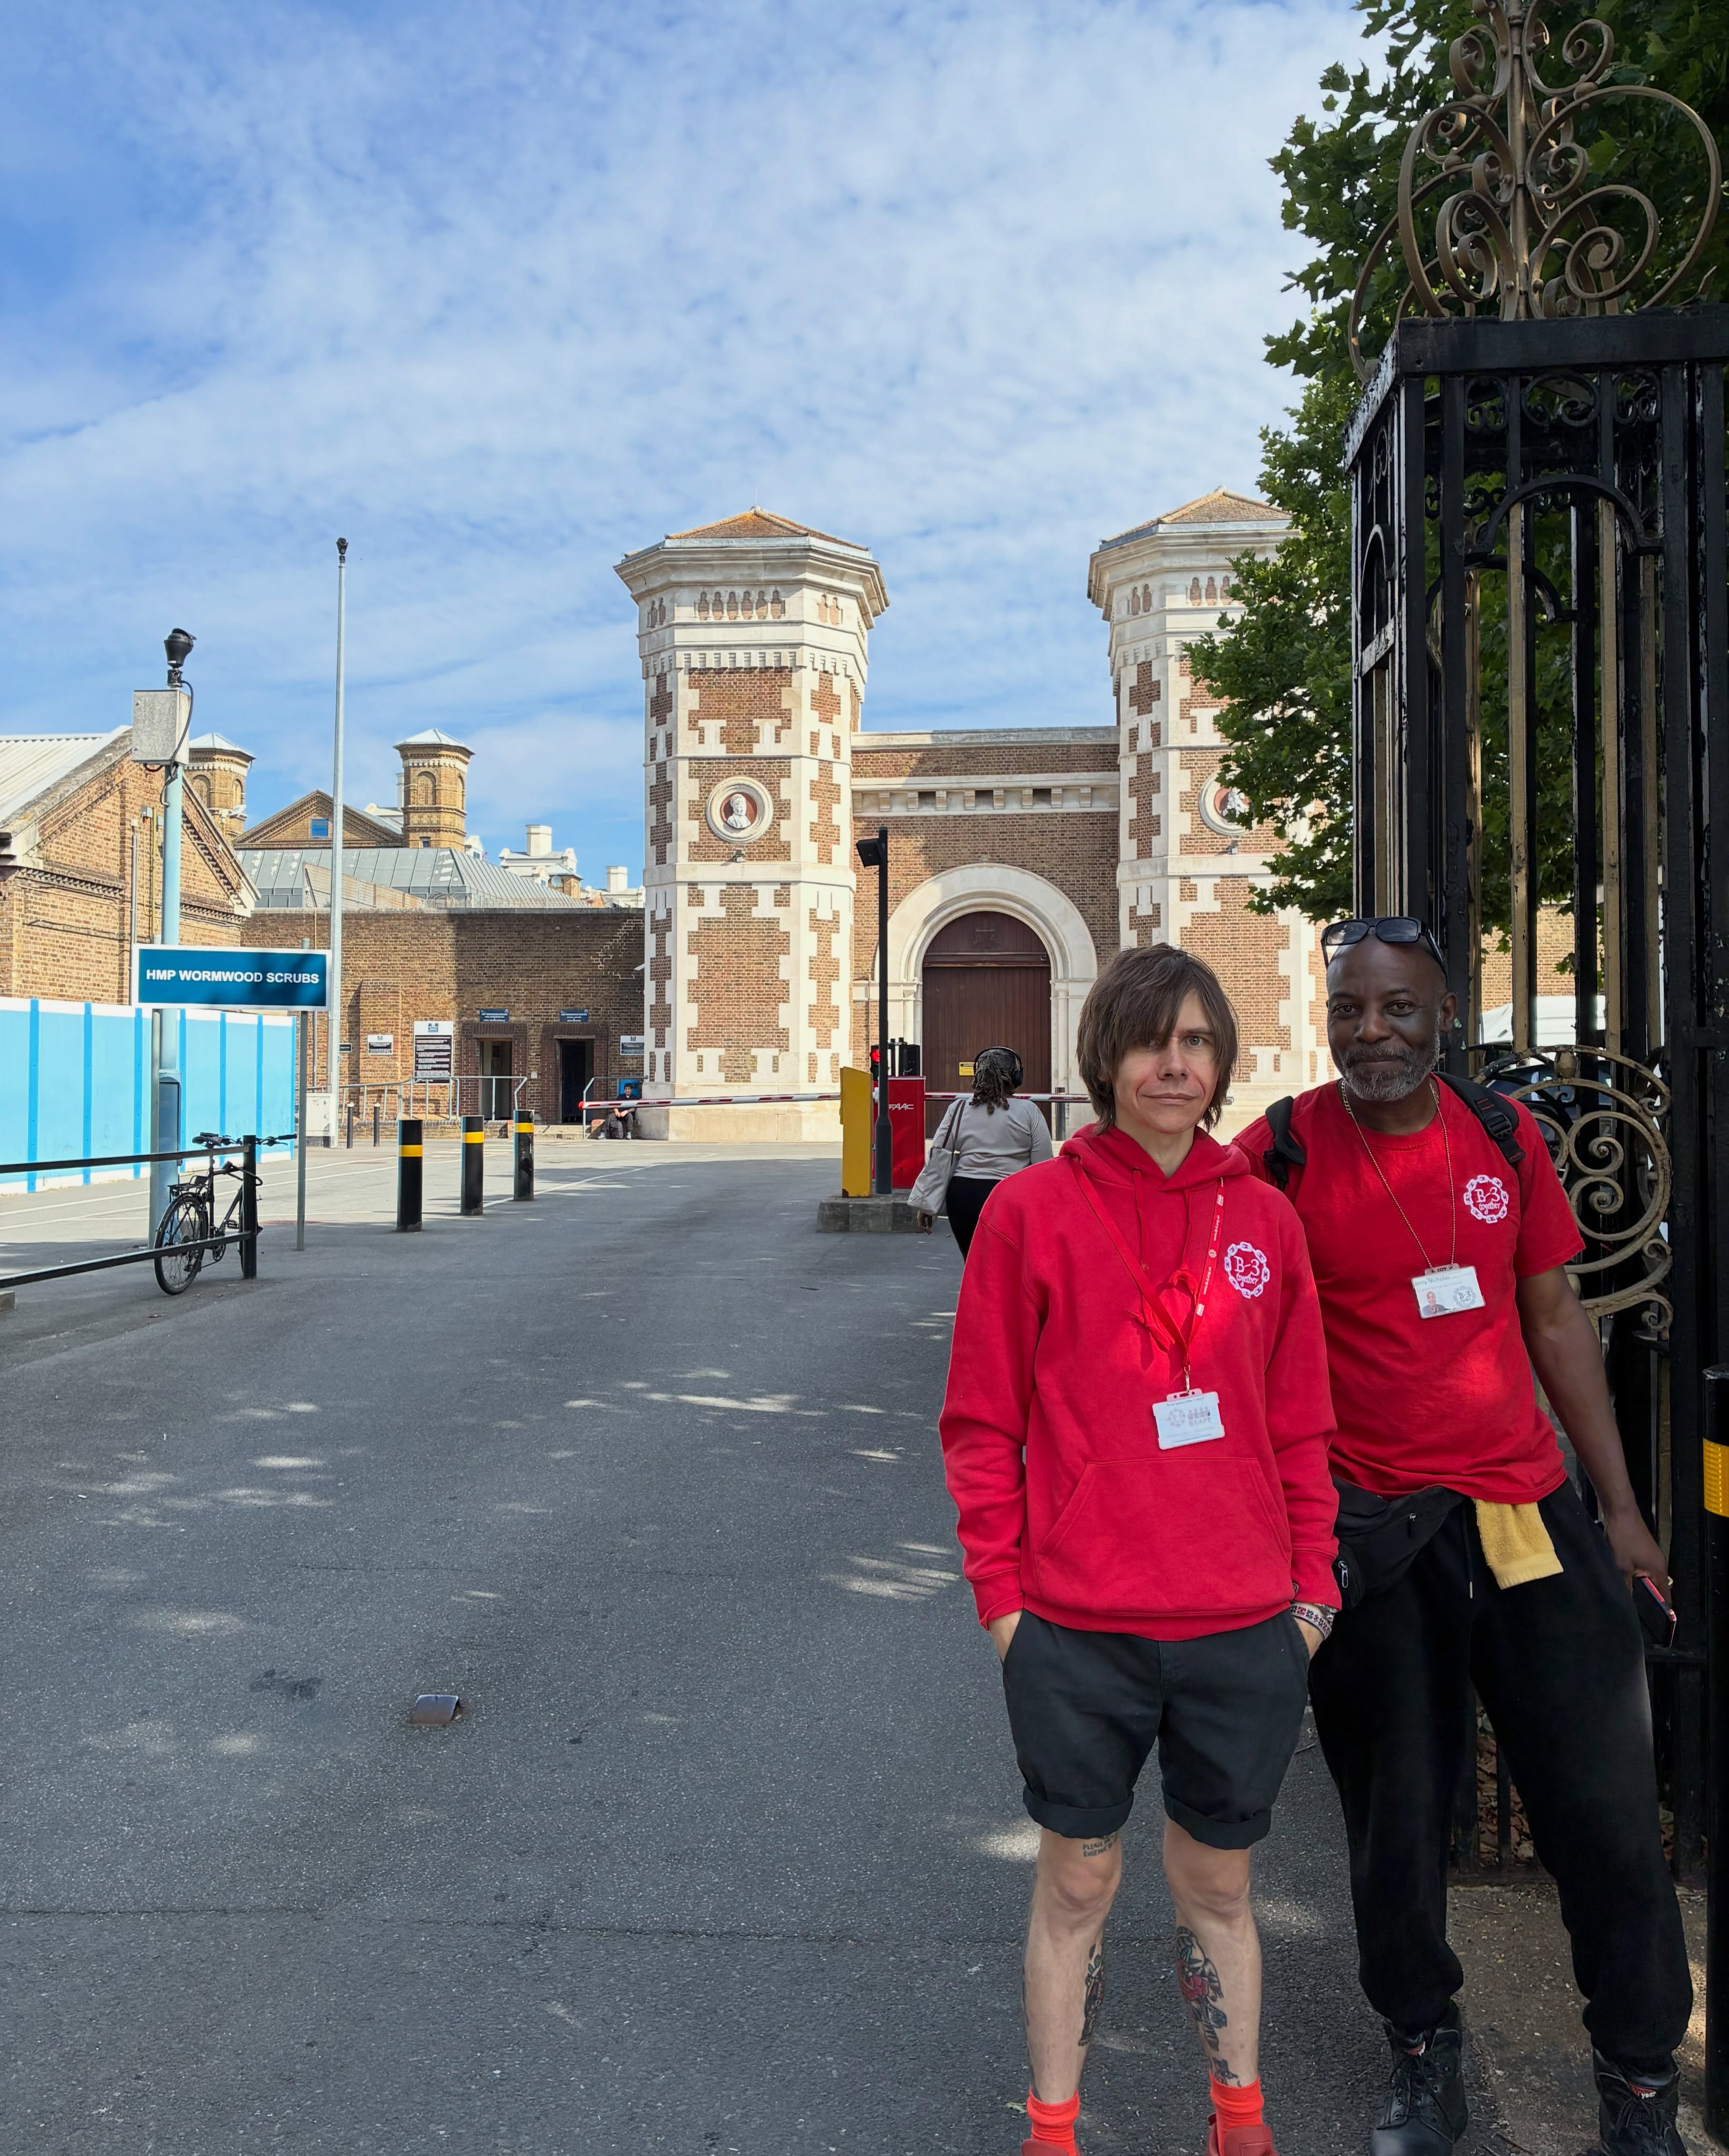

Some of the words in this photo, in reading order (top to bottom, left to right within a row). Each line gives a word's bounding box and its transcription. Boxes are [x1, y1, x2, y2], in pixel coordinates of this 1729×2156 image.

[146, 969, 176, 981] HMP
[179, 970, 263, 982] WORMWOOD
[266, 972, 319, 984] SCRUBS
[1474, 1186, 1501, 1203] B-3
[1478, 1203, 1501, 1215] together
[1234, 1255, 1260, 1276] B-3
[1236, 1272, 1259, 1287] together
[1428, 1275, 1450, 1283] Nicholas
[1458, 1291, 1472, 1300] B-3
